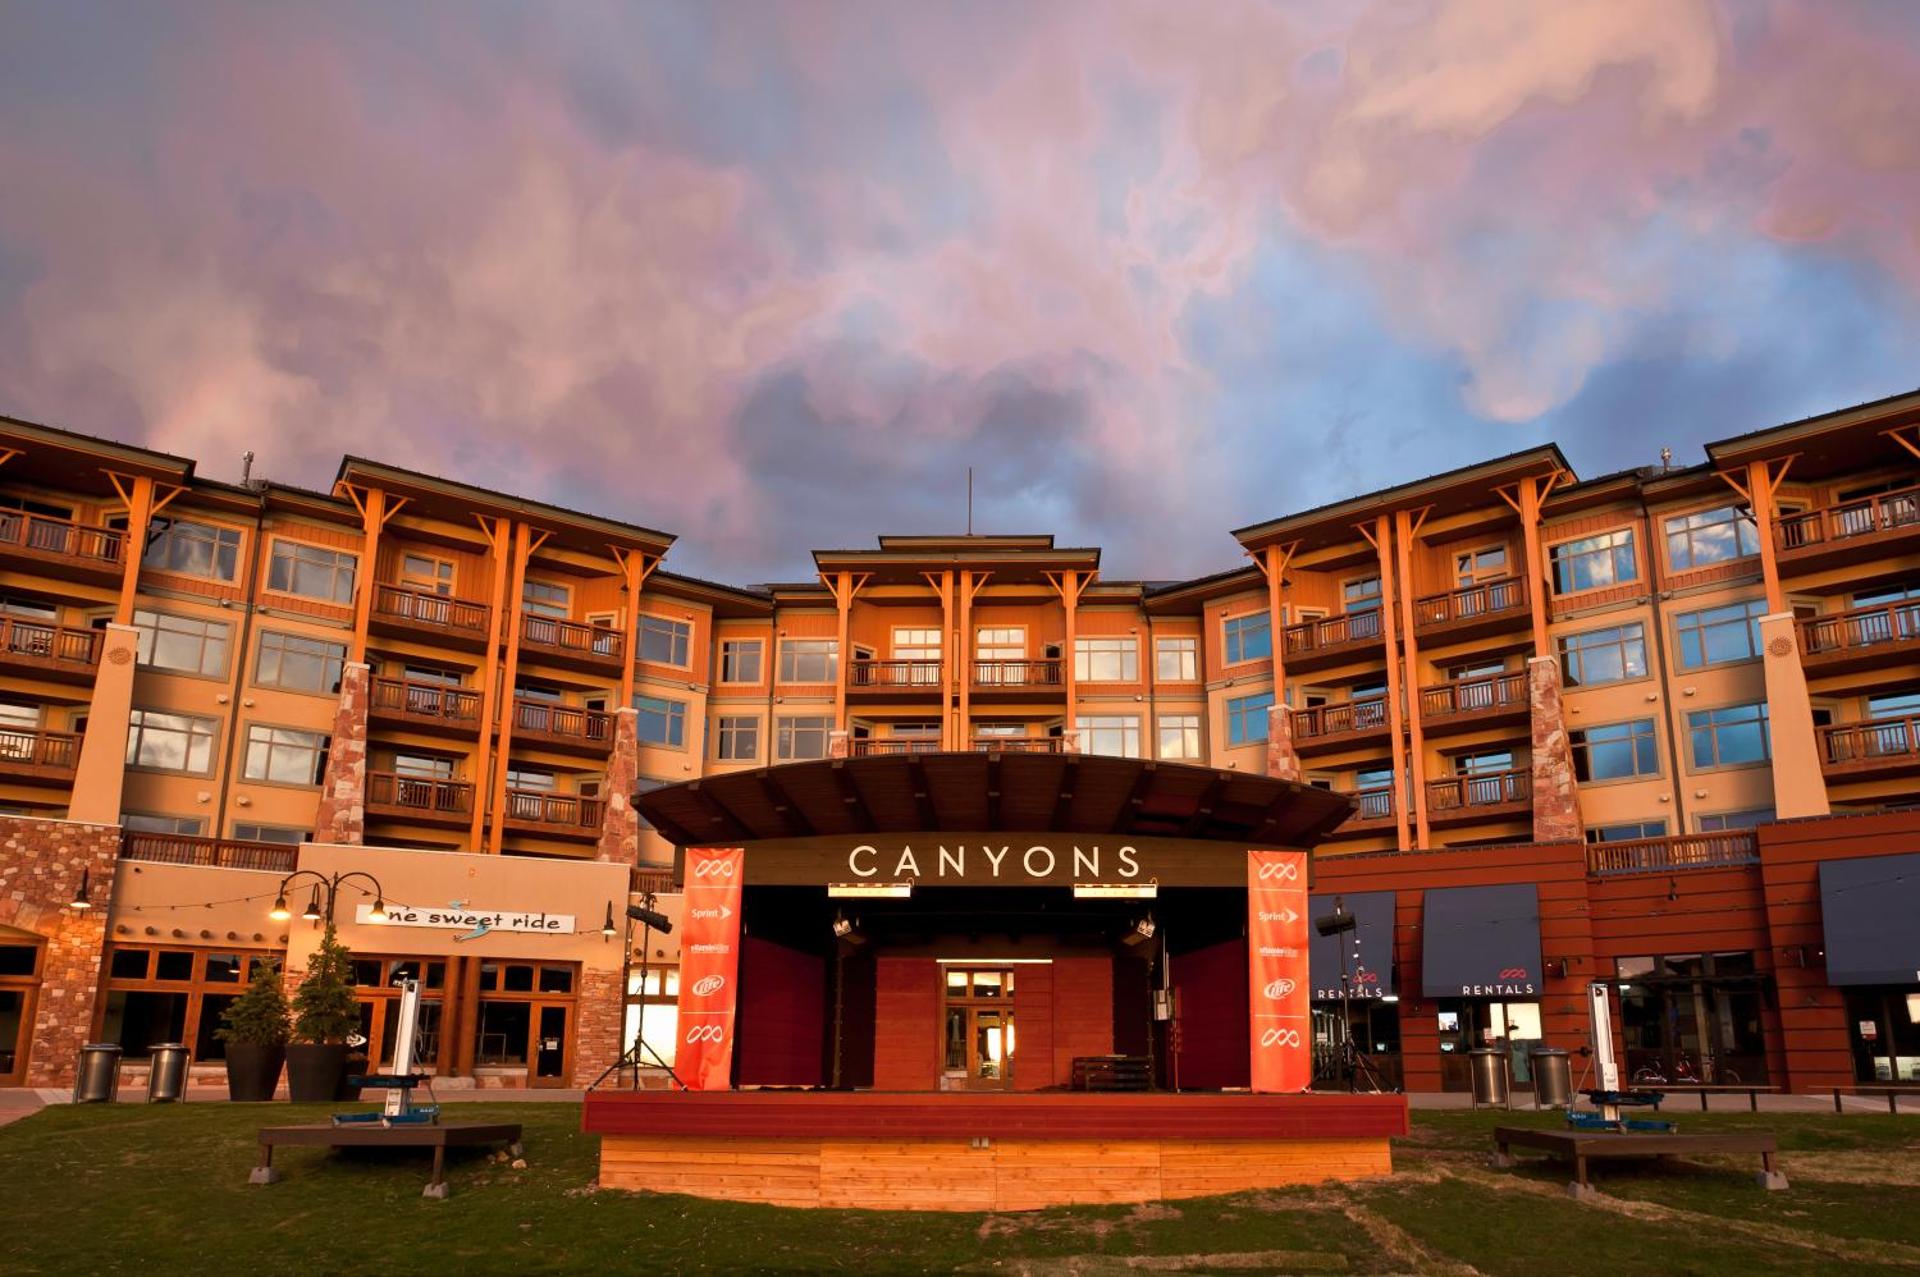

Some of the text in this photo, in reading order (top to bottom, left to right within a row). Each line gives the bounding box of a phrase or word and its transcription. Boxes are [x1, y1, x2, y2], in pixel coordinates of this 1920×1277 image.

[849, 845, 1139, 877] CANYONS
[428, 911, 503, 926] sweet
[512, 912, 560, 929] ride
[691, 908, 718, 920] Sprint
[1462, 984, 1534, 996] RENTALS
